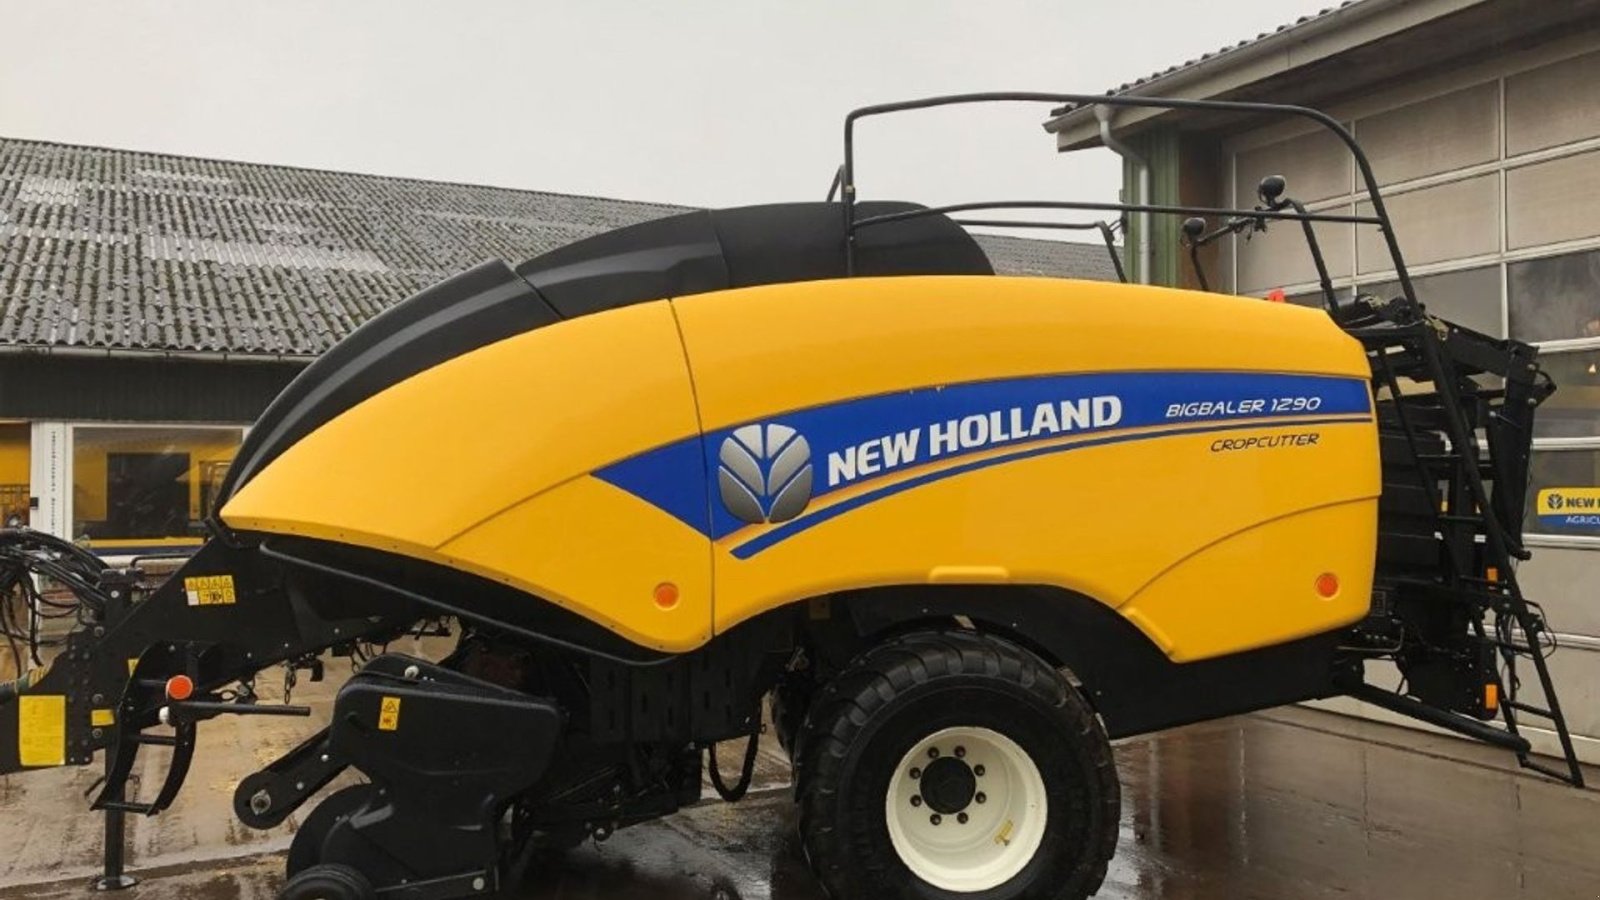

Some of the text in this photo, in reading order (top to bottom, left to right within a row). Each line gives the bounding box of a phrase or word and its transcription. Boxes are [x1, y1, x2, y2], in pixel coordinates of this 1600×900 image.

[1165, 397, 1321, 417] BIGBALER 1290
[828, 395, 1122, 487] NEW HOLLAND
[1211, 433, 1320, 452] CROPCUTTER
[1566, 497, 1595, 508] NEW
